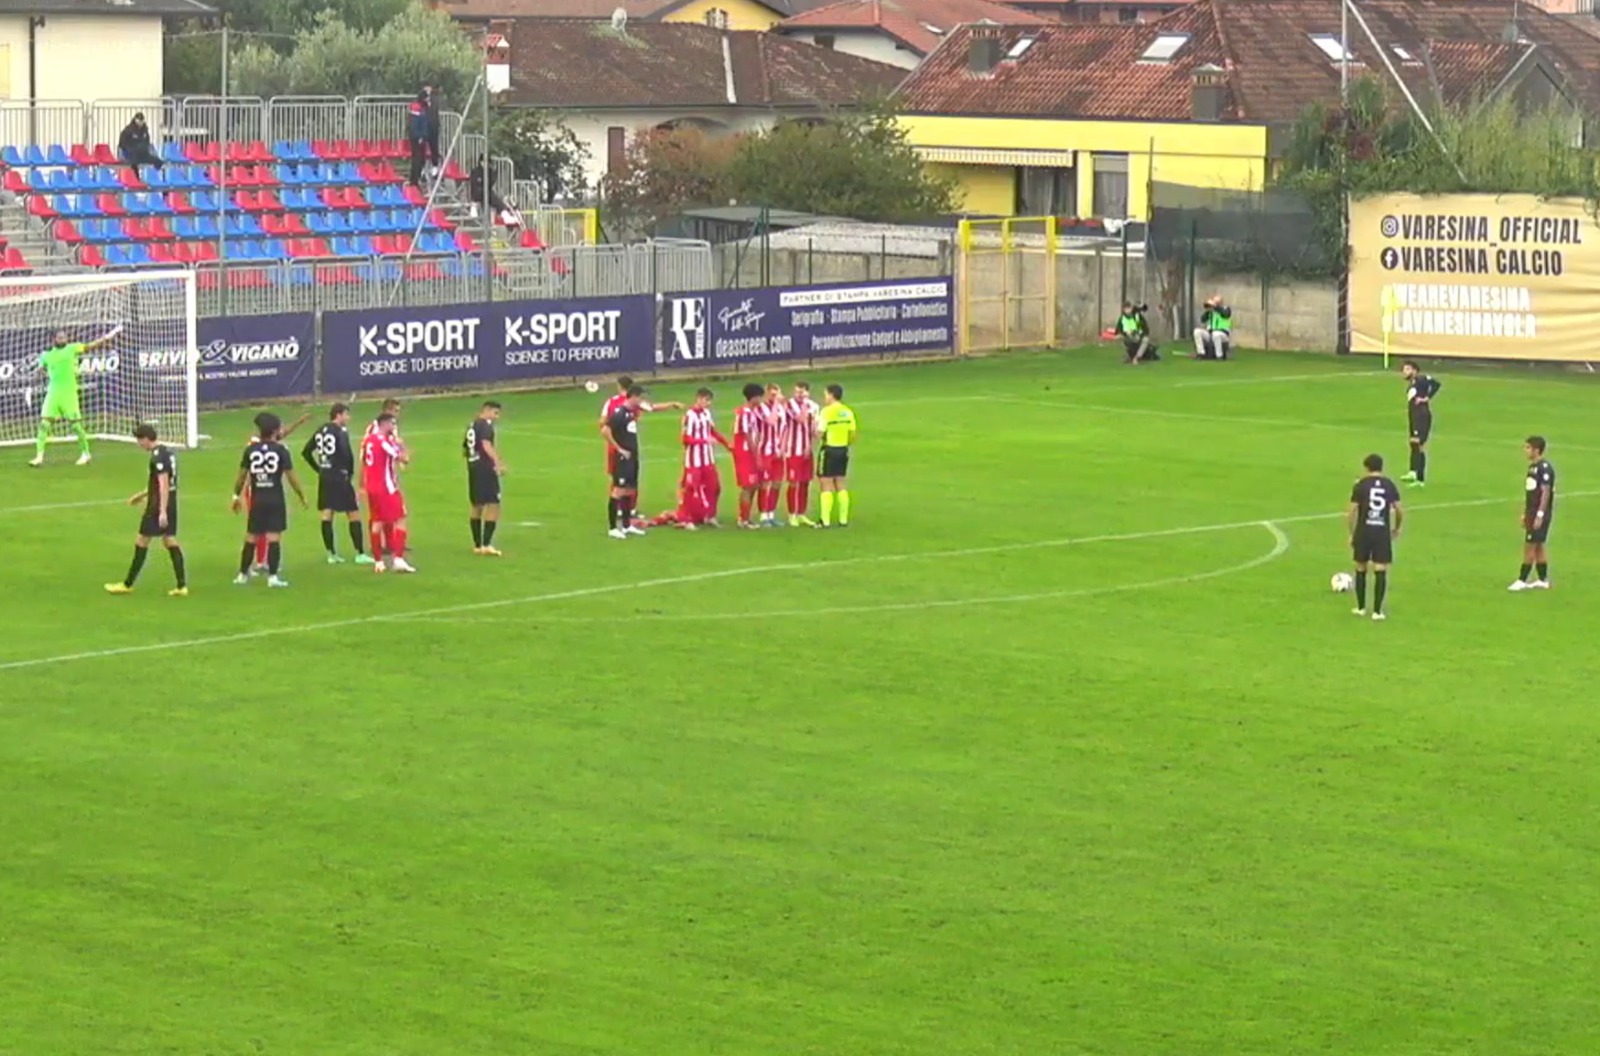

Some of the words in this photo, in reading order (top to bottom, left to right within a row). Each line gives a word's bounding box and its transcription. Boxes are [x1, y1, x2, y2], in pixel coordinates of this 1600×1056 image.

[1402, 215, 1581, 247] VARESINA_OFFICIAL
[1402, 247, 1489, 274] VARESINA
[1496, 249, 1562, 276] CALCIO
[783, 294, 821, 302] PARTNER
[837, 290, 869, 300] STAMPA
[873, 287, 912, 297] VARESINA
[916, 285, 944, 295] CALCIO
[1382, 283, 1531, 311] WEAREVARESINA
[505, 310, 621, 346] K-SPORT
[1383, 309, 1537, 338] LAVARESINAVOLA
[231, 336, 300, 361] VIGANÒ
[359, 318, 481, 357] K-SPORT
[715, 335, 793, 358] deascreen.com
[360, 358, 408, 376] SCIENCE
[410, 357, 425, 373] TO
[426, 354, 479, 371] PERFORM
[505, 349, 550, 365] SCIENCE
[552, 347, 567, 362] TO
[568, 346, 620, 362] PERFORM
[314, 433, 336, 455] 33
[250, 451, 279, 473] 23
[1369, 488, 1386, 511] 5
